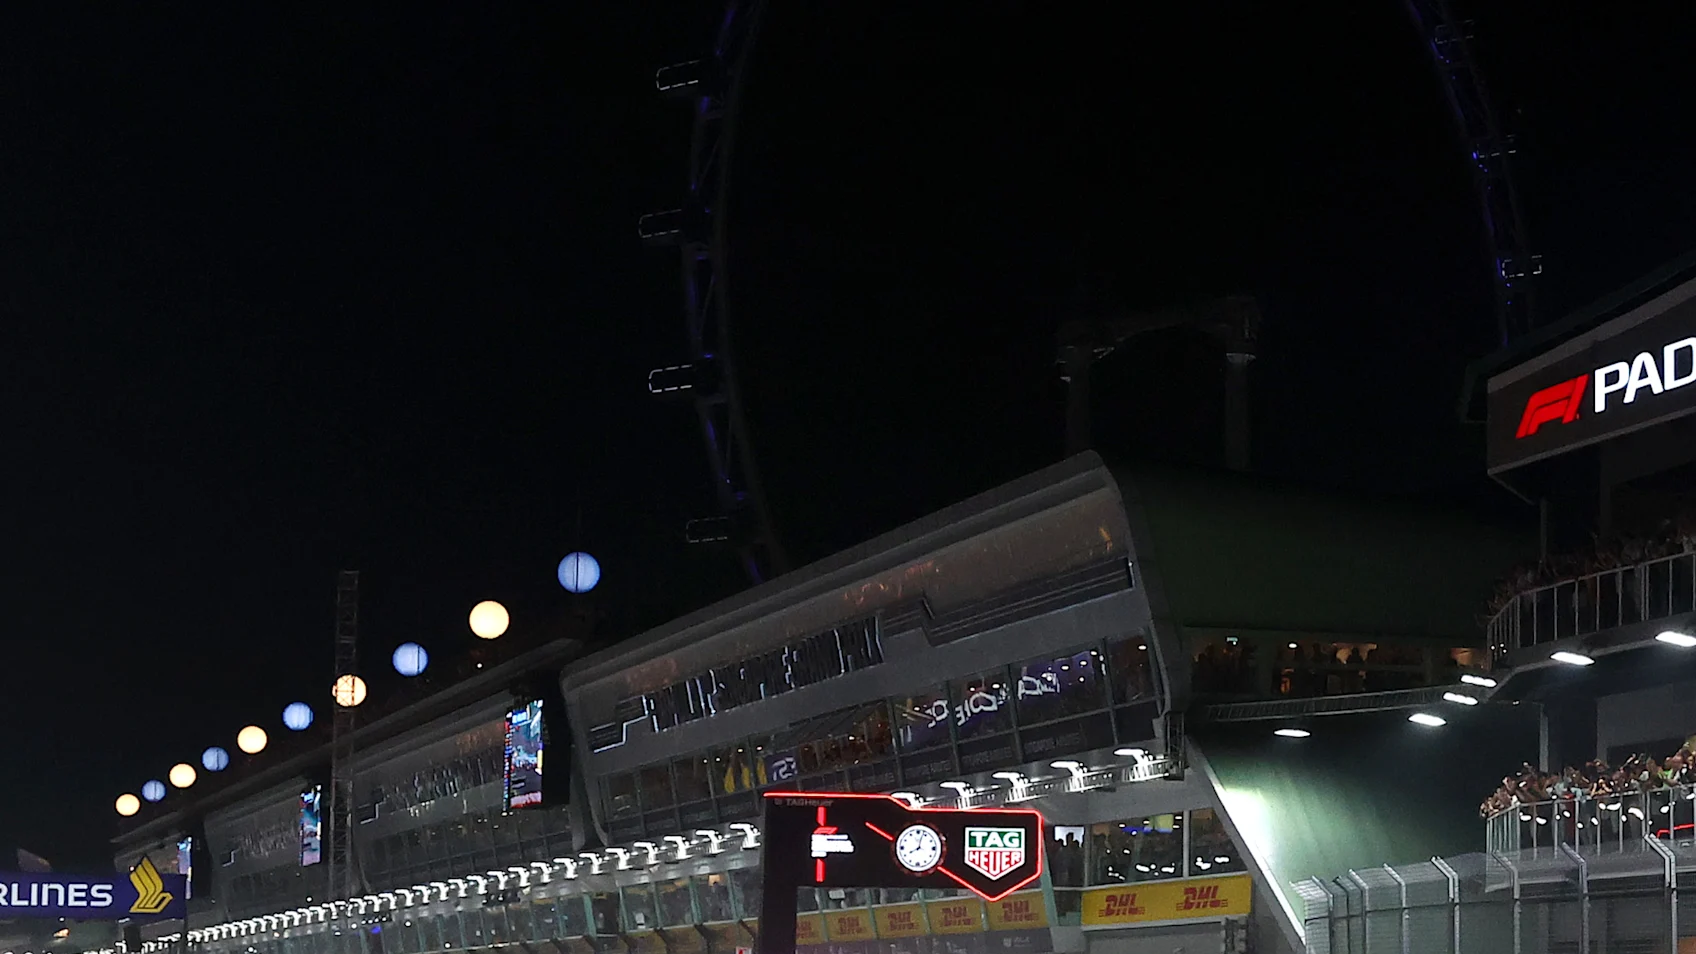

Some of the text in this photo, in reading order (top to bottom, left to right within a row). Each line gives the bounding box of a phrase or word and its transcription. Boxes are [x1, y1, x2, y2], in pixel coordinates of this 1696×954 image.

[971, 832, 1021, 847] TAG
[968, 851, 1022, 877] HEUER
[1101, 893, 1143, 917] DHL
[1180, 885, 1225, 911] DHL
